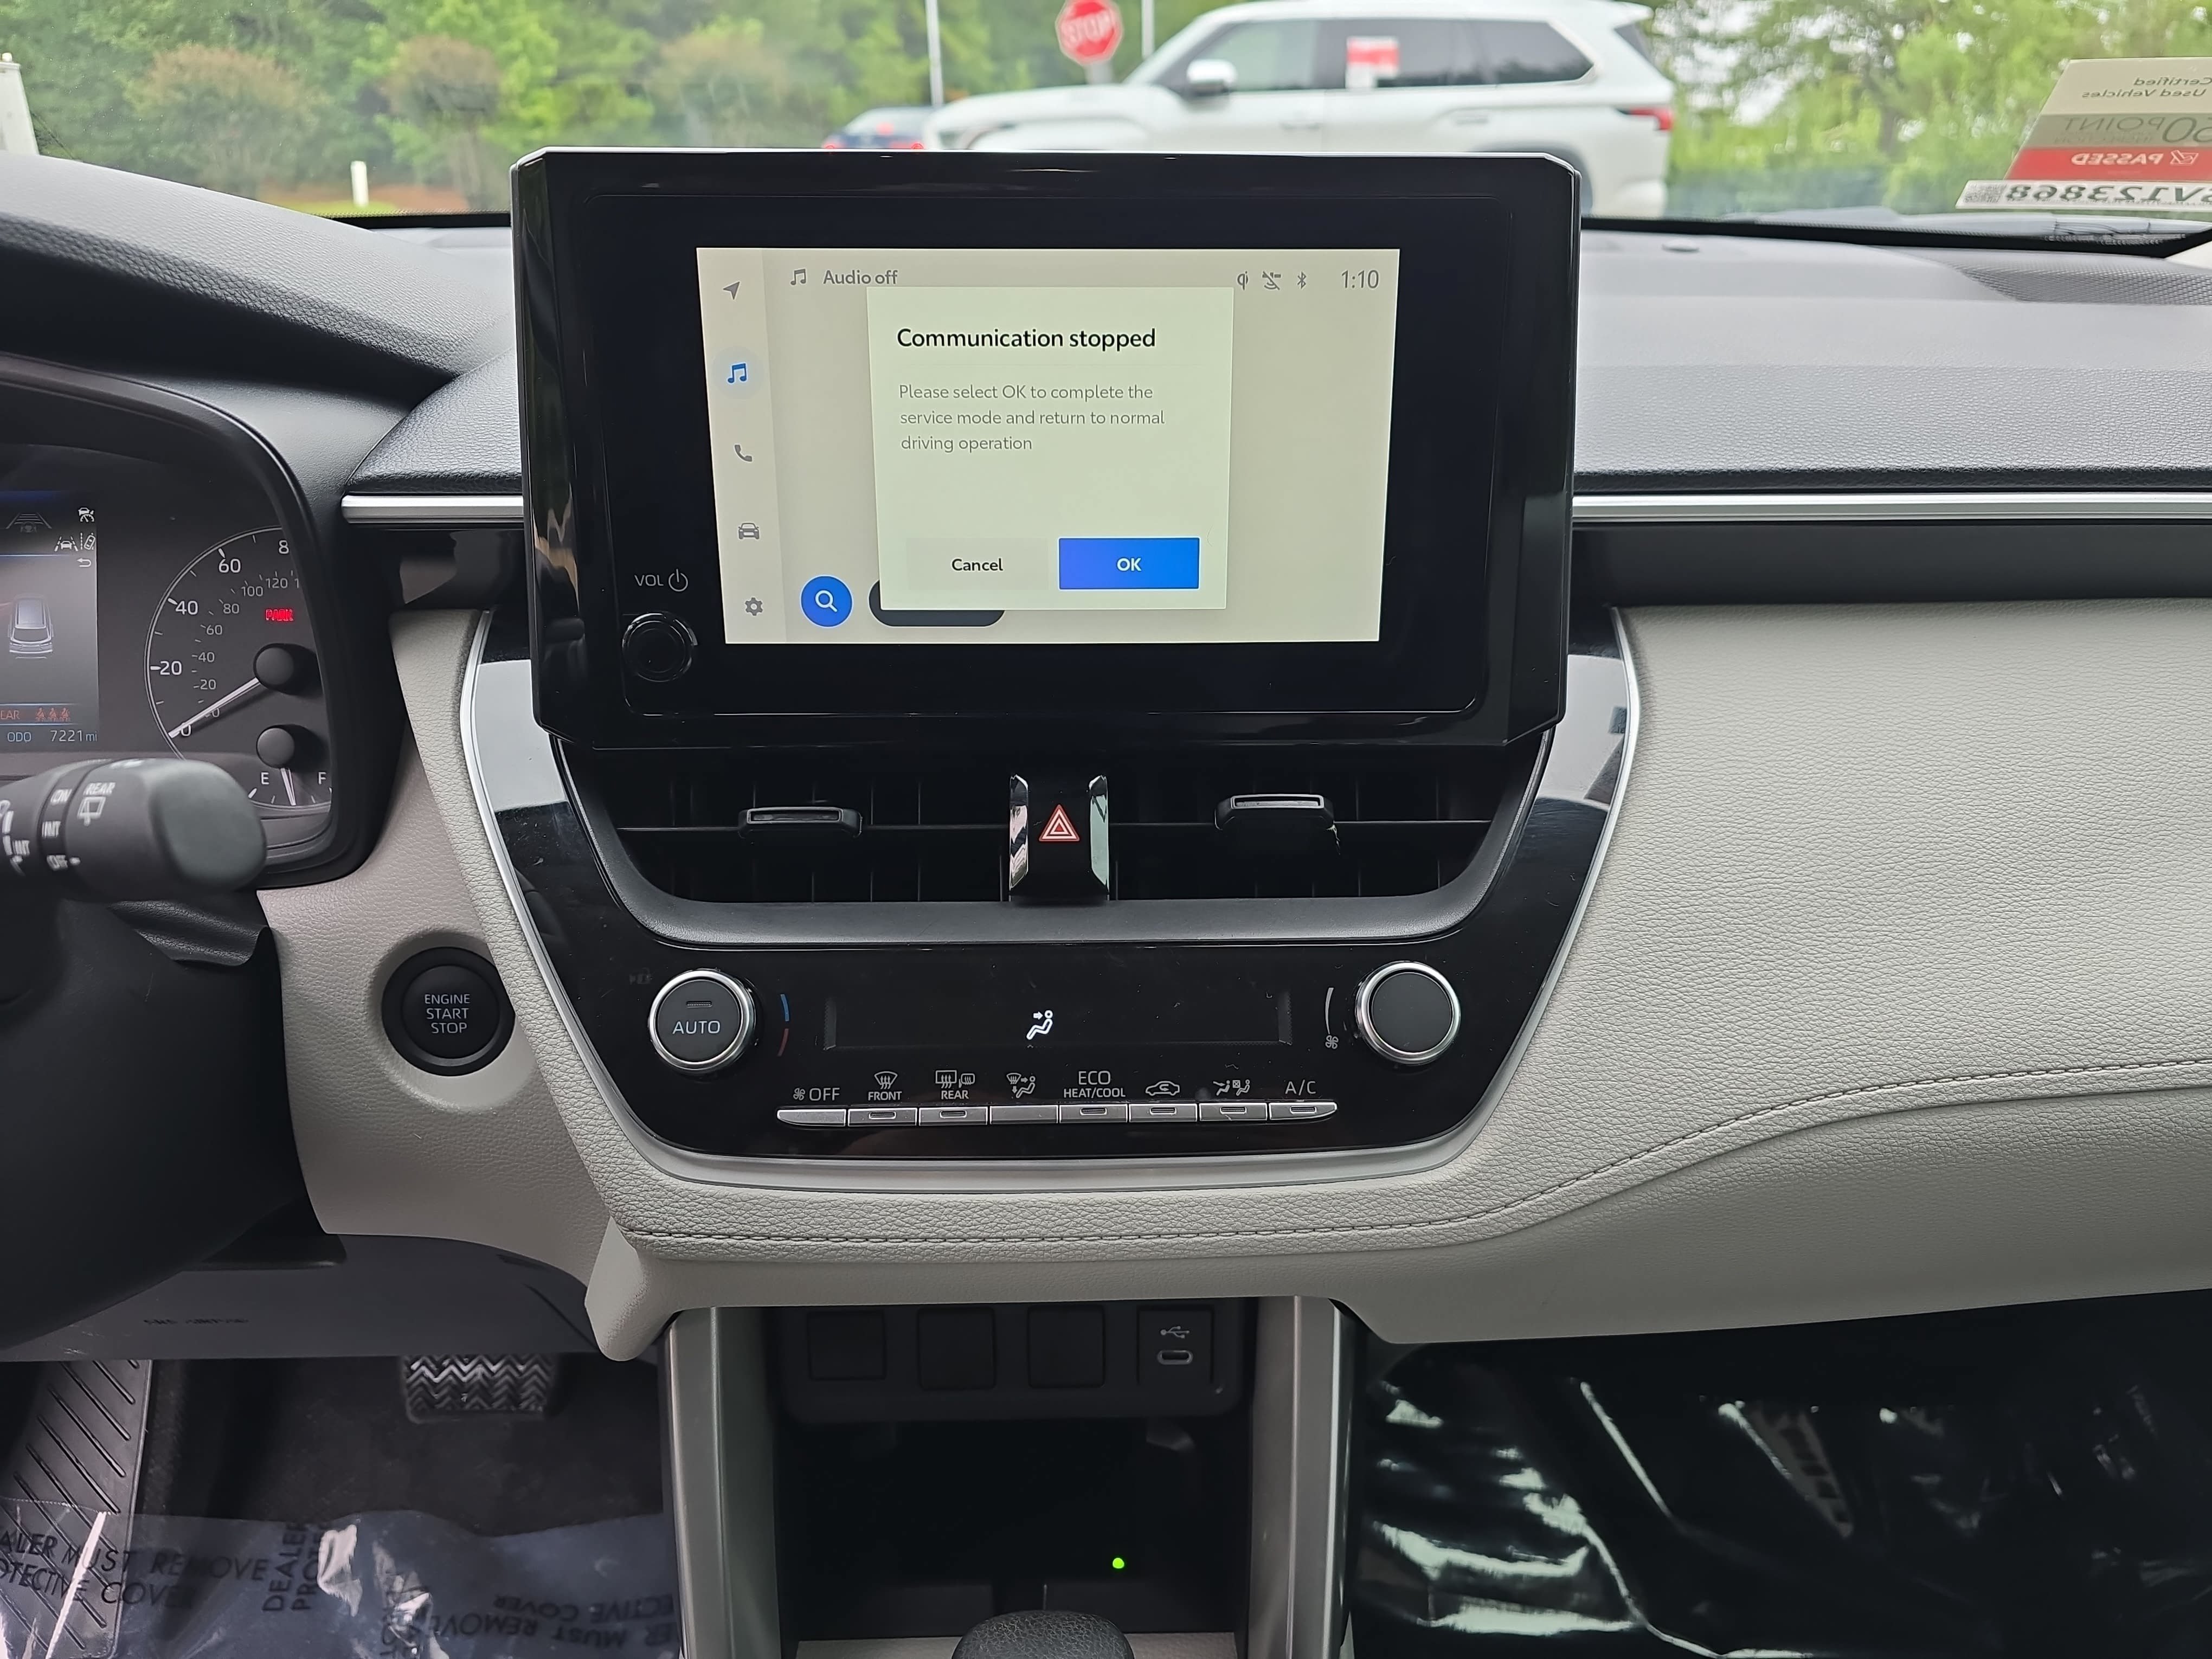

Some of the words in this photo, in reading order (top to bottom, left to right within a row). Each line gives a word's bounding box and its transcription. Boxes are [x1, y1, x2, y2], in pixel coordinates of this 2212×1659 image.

[1060, 11, 1112, 47] STOP
[823, 270, 871, 285] Audio
[874, 270, 899, 285] off
[1341, 269, 1380, 289] 1:10
[897, 328, 1064, 348] Communication
[1069, 328, 1156, 351] stopped
[899, 384, 949, 399] Please
[953, 384, 998, 399] select
[1002, 385, 1027, 399] OK
[1030, 387, 1047, 399] to
[1051, 384, 1124, 402] complete
[1128, 384, 1153, 399] the
[900, 410, 953, 425] service
[957, 410, 1002, 425] mode
[1006, 410, 1036, 425] and
[1039, 412, 1085, 425] return
[1090, 412, 1106, 425] to
[1110, 410, 1165, 425] normal
[901, 436, 954, 452] driving
[958, 437, 1032, 452] operation
[218, 558, 241, 573] 60
[951, 558, 1004, 571] Cancel
[1116, 558, 1142, 571] OK
[266, 578, 288, 589] 120
[634, 574, 664, 586] VOL
[241, 586, 263, 597] 100
[175, 600, 198, 615] 40
[223, 603, 240, 614] 80
[265, 608, 295, 622] PARK
[206, 625, 223, 635] 60
[198, 652, 215, 663] 40
[159, 660, 182, 676] 20
[200, 679, 216, 690] 20
[7, 731, 32, 742] ODO
[50, 730, 83, 742] 7221
[86, 731, 98, 742] mi
[261, 771, 269, 785] E
[318, 771, 326, 785] F
[83, 782, 116, 795] REAR
[50, 789, 72, 804] ON
[425, 994, 471, 1004] ENGINE
[426, 1008, 469, 1019] START
[431, 1023, 467, 1033] STOP
[672, 1020, 721, 1034] AUTO
[1078, 1070, 1111, 1085] ECO
[809, 1087, 840, 1101] OFF
[1063, 1088, 1126, 1098] HEAT/COOL
[1285, 1080, 1316, 1094] A/C
[868, 1091, 902, 1101] FRONT
[941, 1090, 969, 1100] REAR
[493, 1594, 578, 1622] COVER
